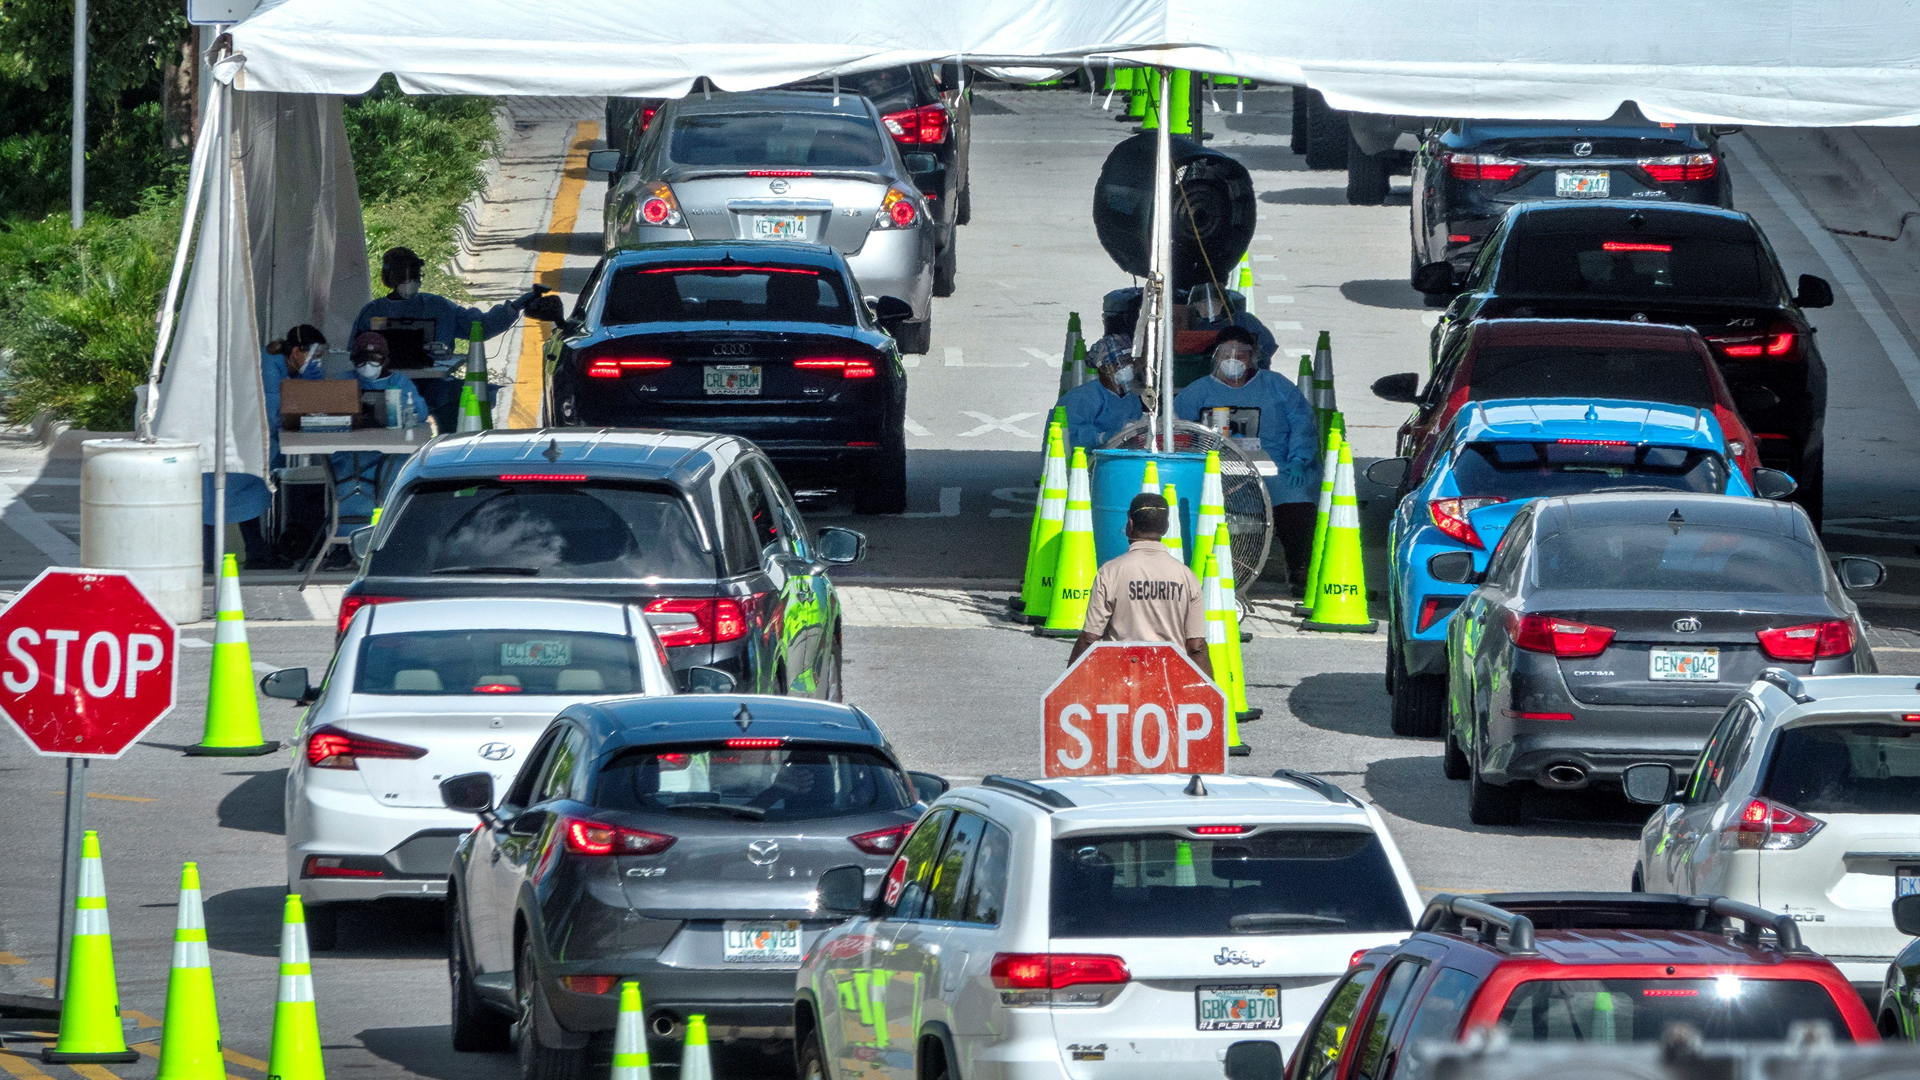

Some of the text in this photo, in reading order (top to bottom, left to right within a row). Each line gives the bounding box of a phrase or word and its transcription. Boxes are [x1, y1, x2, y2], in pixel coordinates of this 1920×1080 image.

[755, 220, 804, 234] KET M14
[706, 373, 726, 388] CRL
[1062, 588, 1090, 600] MDF
[1129, 580, 1185, 602] SECURITY
[1324, 583, 1359, 596] MDFR
[1676, 622, 1698, 631] KIA
[2, 626, 164, 699] STOP
[1654, 655, 1678, 672] CEN
[1056, 703, 1213, 770] STOP
[1900, 877, 1920, 897] CK
[1213, 946, 1266, 968] Jeep
[1202, 998, 1275, 1019] GBK B70
[1199, 1019, 1215, 1030] #1
[1264, 1016, 1281, 1029] #1
[1066, 1043, 1109, 1051] 4x4
